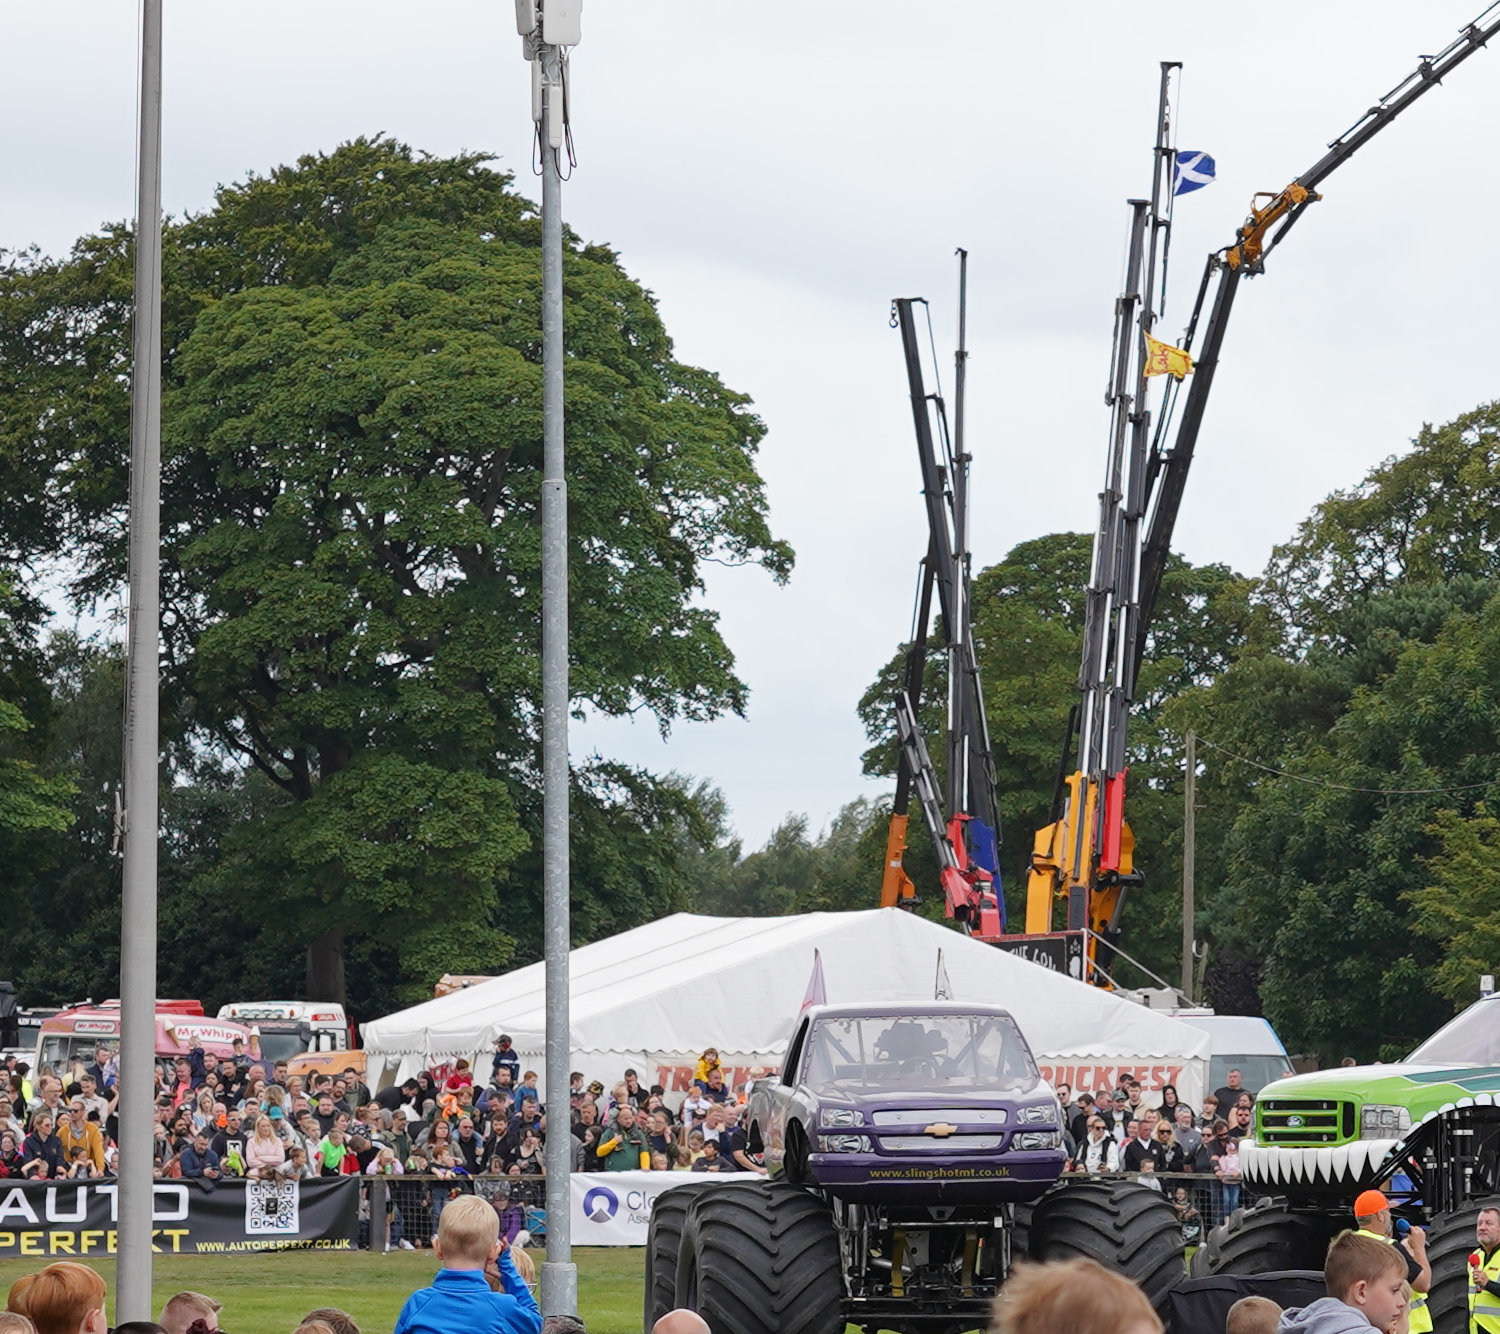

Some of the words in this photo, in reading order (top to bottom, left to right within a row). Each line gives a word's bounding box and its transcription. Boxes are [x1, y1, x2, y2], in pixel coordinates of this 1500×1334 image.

[1039, 1066, 1183, 1093] RUCKFEST
[869, 1166, 1010, 1179] www.slingshotmt.co.uk
[195, 1238, 351, 1253] WWW.AUTOPERFEKT.CO.UK
